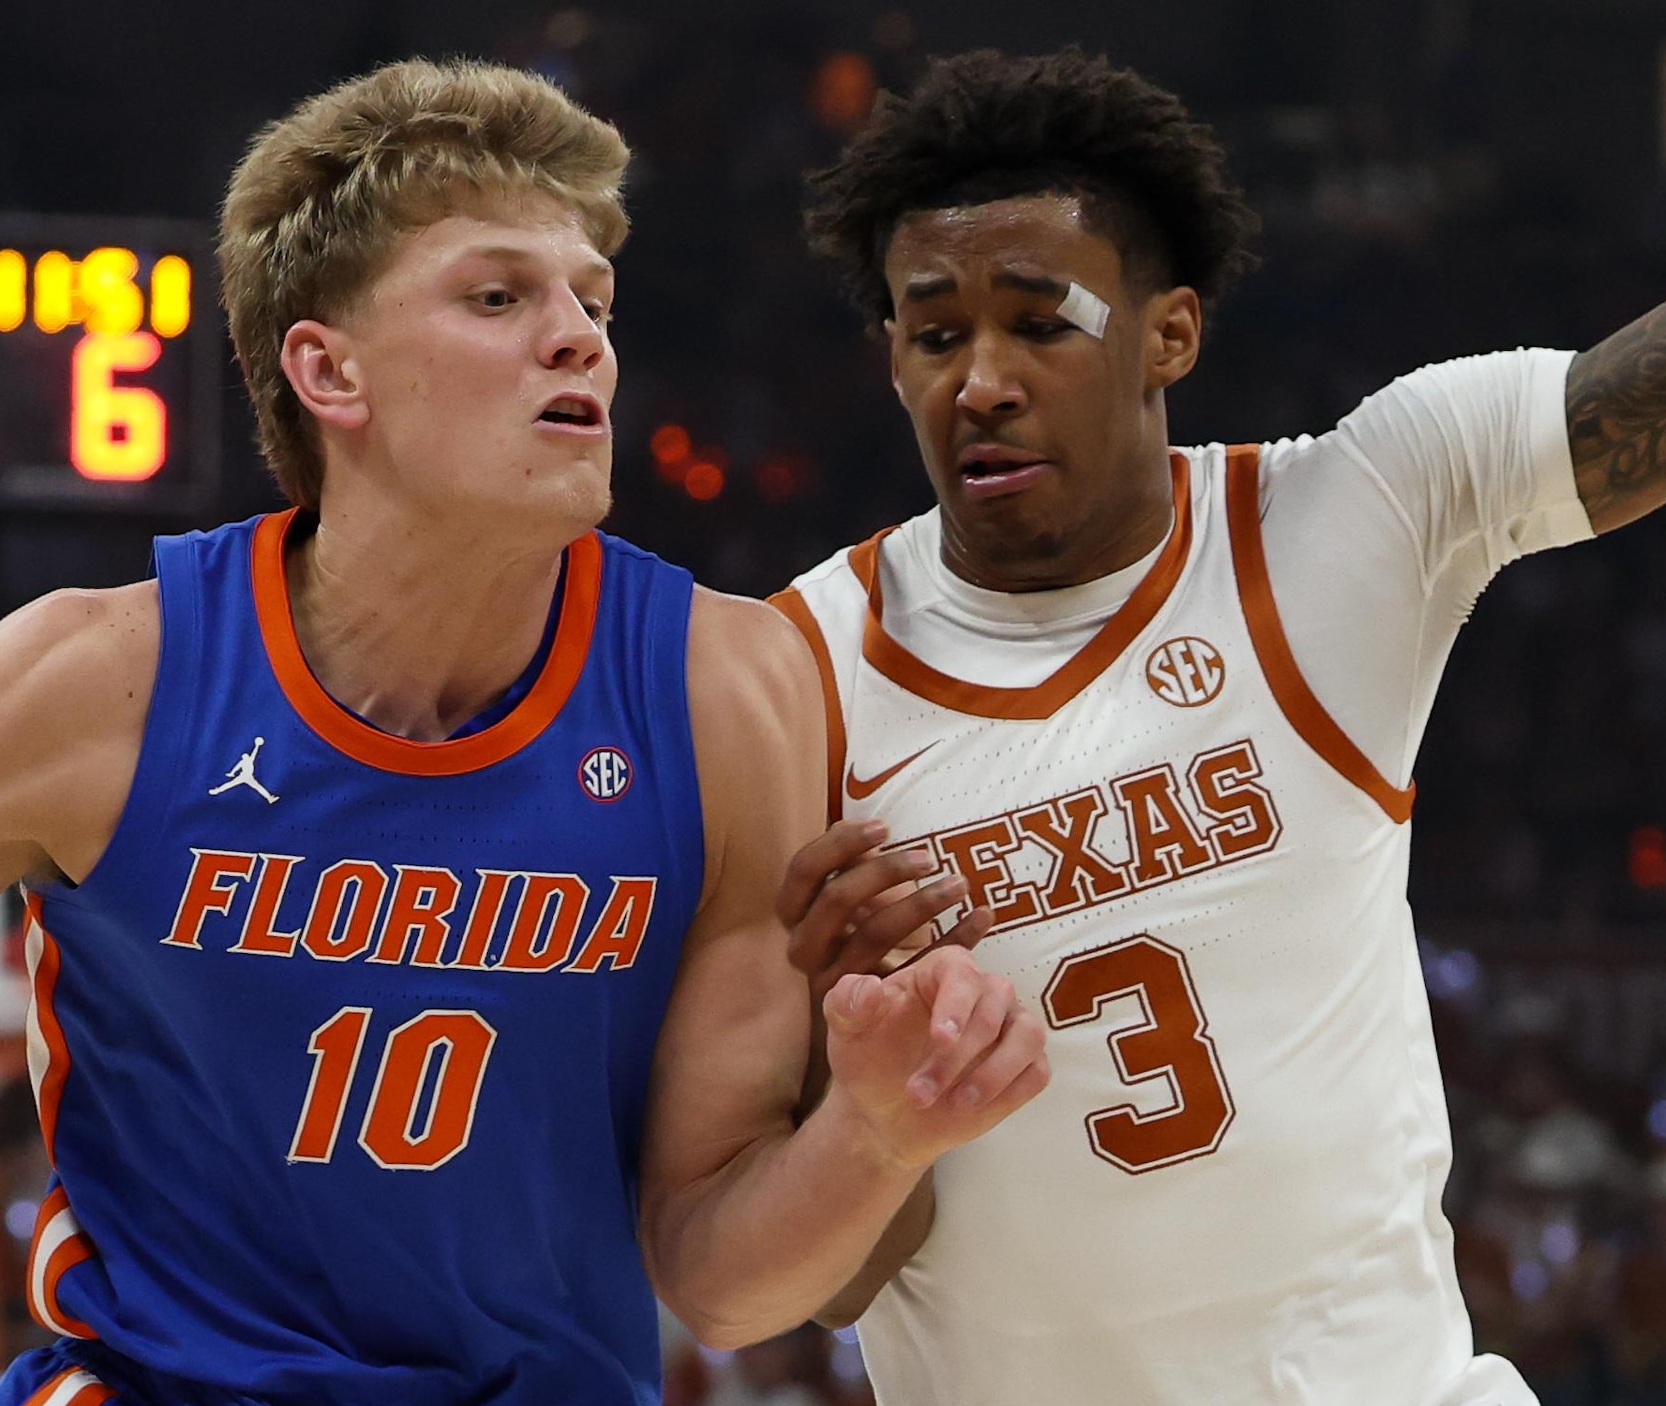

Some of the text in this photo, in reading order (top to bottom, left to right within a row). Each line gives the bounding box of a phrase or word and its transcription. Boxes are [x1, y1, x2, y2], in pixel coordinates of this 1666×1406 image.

[70, 332, 168, 481] 6
[1146, 638, 1224, 706] SEC
[580, 749, 631, 799] SEC
[879, 738, 1284, 942] EXAS
[160, 847, 658, 974] FLORIDA
[286, 1006, 499, 1171] 10
[1041, 933, 1236, 1175] 3
